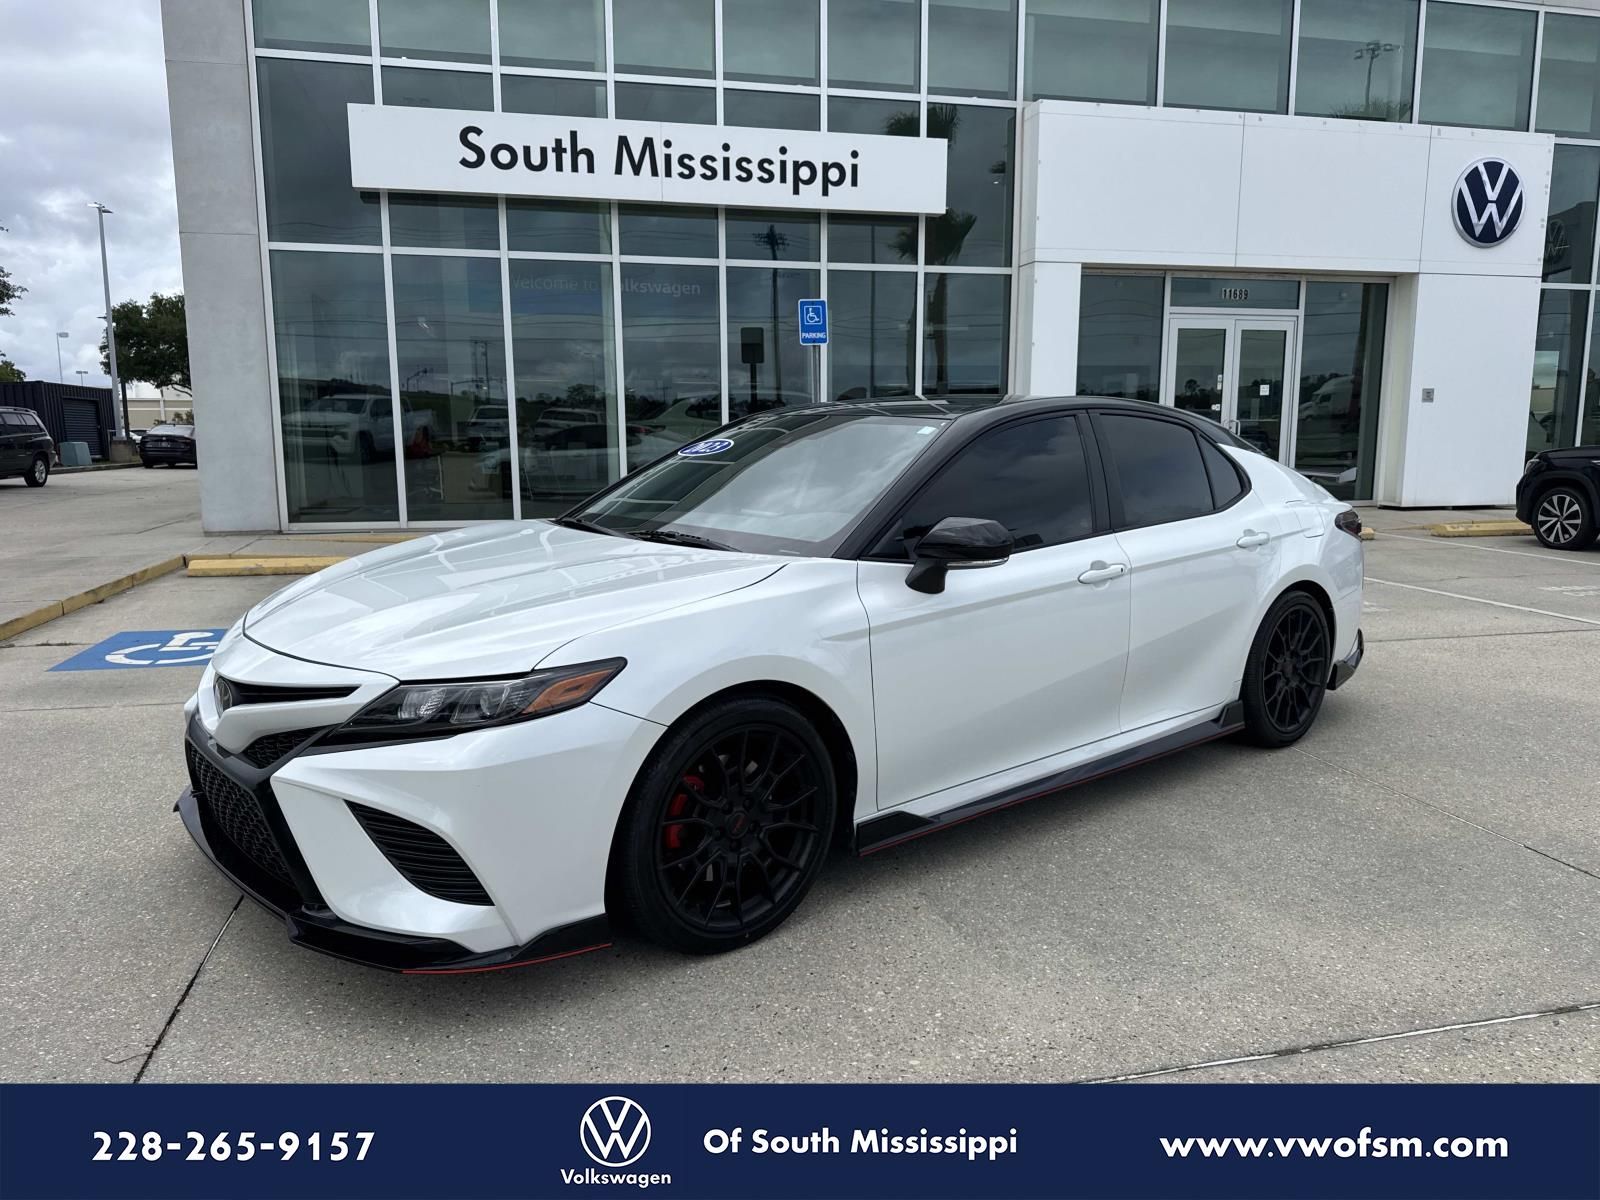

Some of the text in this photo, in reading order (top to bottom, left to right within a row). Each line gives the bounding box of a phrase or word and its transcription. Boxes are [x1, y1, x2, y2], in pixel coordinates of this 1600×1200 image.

[459, 125, 859, 197] South Mississippi
[1455, 160, 1522, 239] VW
[1221, 288, 1249, 300] 11689
